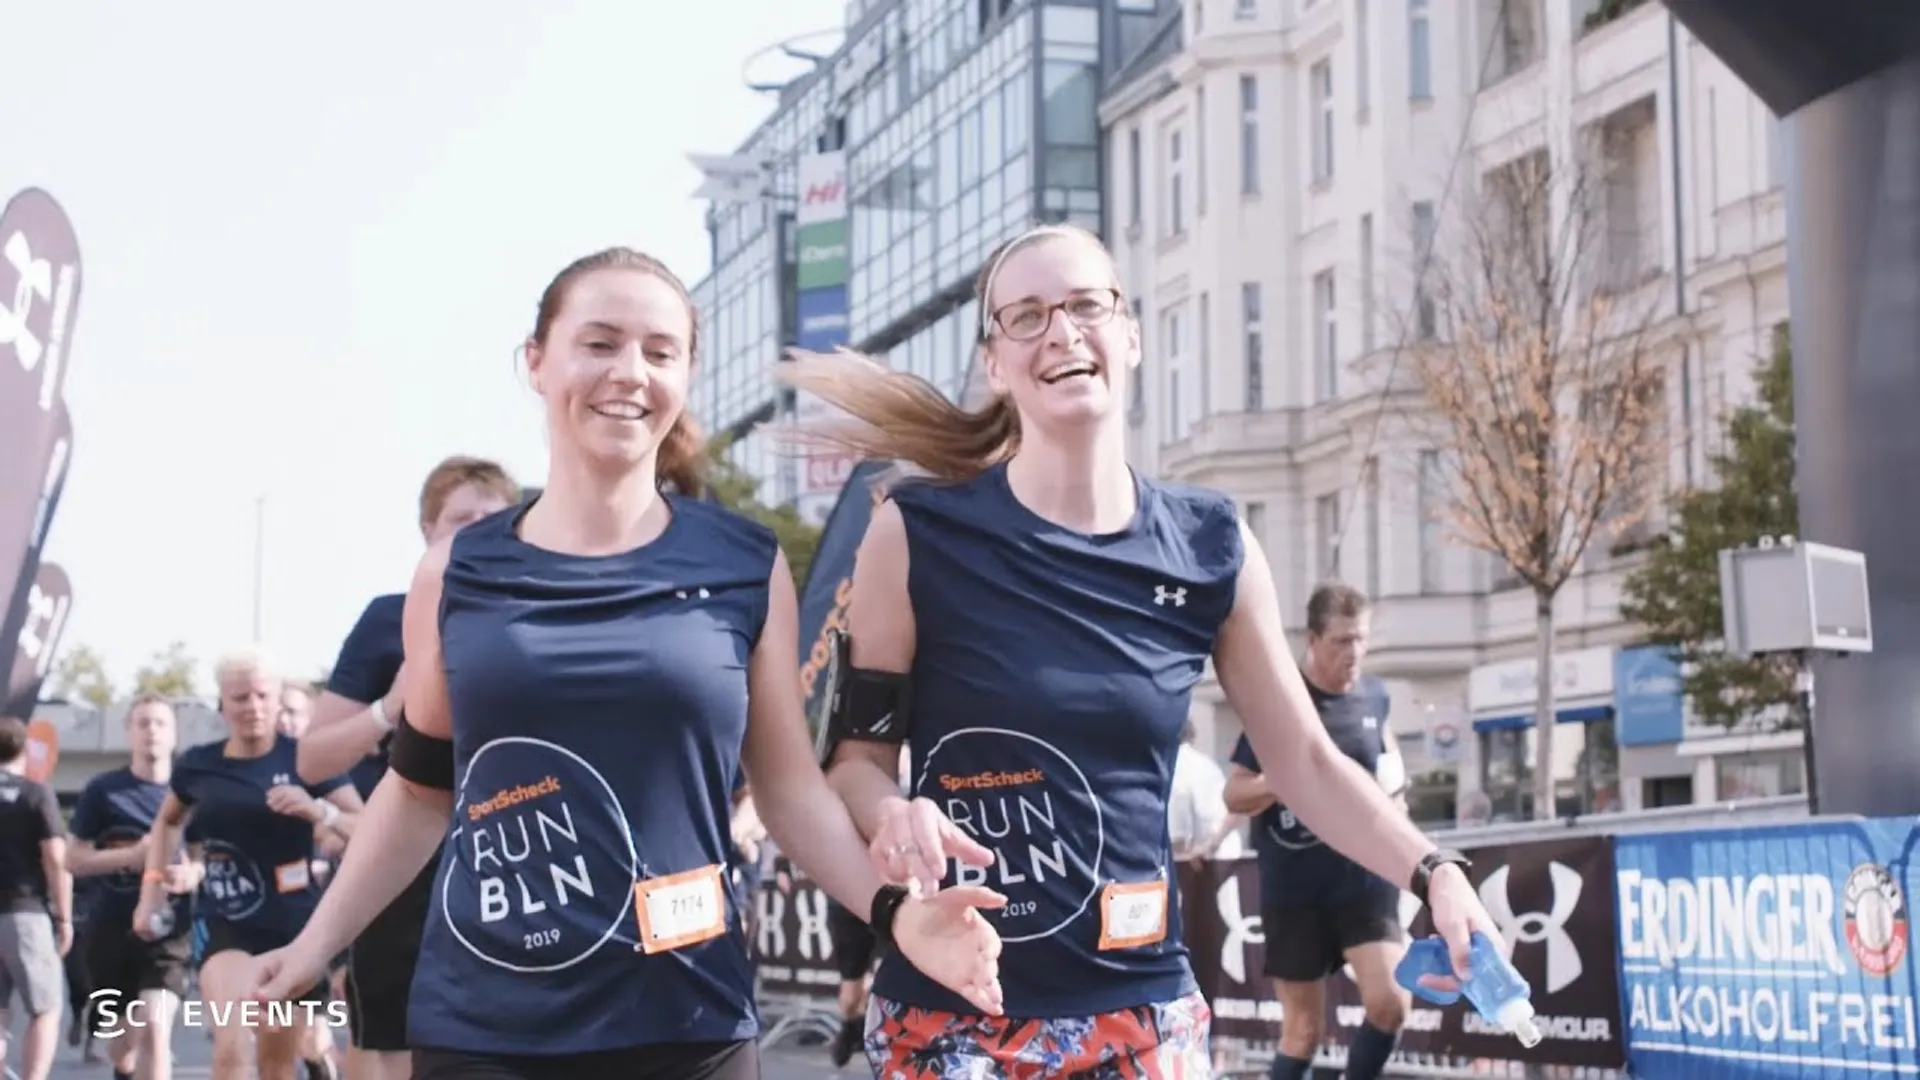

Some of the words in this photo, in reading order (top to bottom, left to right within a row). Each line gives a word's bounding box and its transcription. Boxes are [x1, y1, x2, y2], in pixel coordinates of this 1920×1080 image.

[939, 768, 1045, 793] SportScheck
[472, 801, 579, 873] RUN
[947, 791, 1056, 838] RUN
[480, 854, 595, 923] BLN
[1001, 901, 1037, 919] 2019
[523, 929, 561, 950] 2019
[1616, 869, 1847, 976] ERDINGER
[1629, 983, 1918, 1050] ALKOHOLFREI
